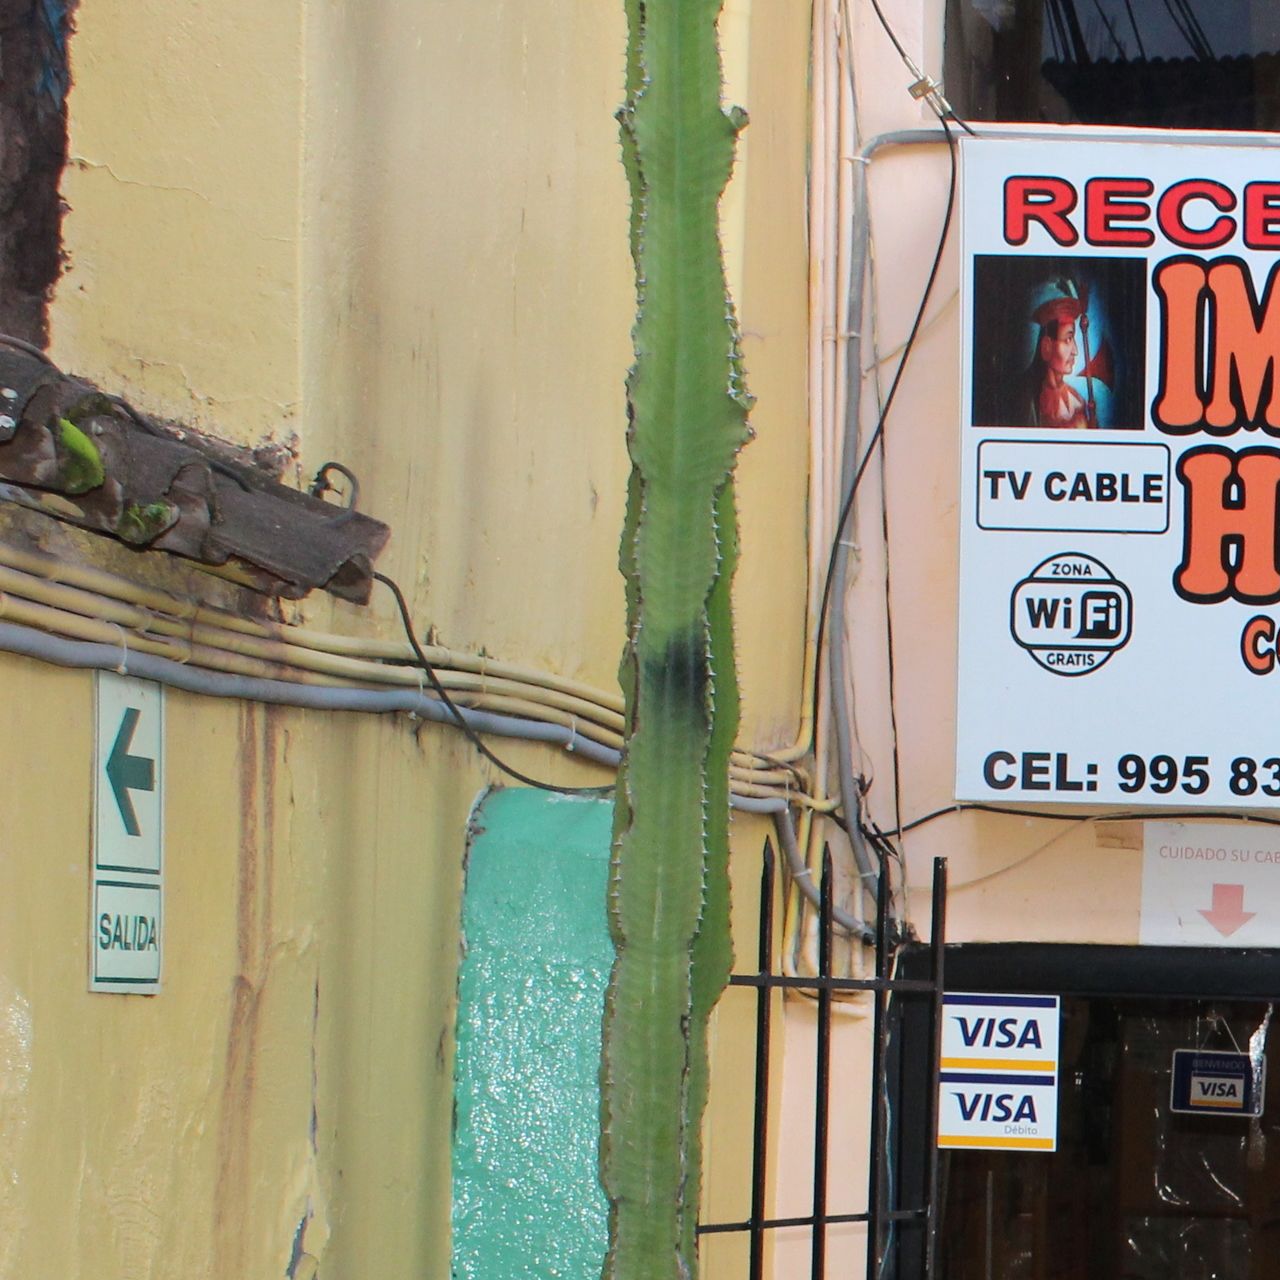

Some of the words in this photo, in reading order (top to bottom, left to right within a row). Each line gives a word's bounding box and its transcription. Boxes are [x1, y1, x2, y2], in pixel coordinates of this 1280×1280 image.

[983, 469, 1032, 501] TV
[1043, 470, 1164, 504] CABLE
[1051, 563, 1093, 577] ZONA
[1046, 652, 1096, 667] GRATIS
[982, 750, 1098, 792] CEL:
[1117, 753, 1210, 796] 995
[1159, 845, 1227, 862] CUIDADO
[1231, 849, 1250, 863] SU
[99, 912, 158, 952] SALIDA
[950, 1016, 1042, 1049] VISA
[1198, 1081, 1237, 1098] VISA
[950, 1092, 1038, 1124] VISA
[1004, 1124, 1038, 1136] Débito
